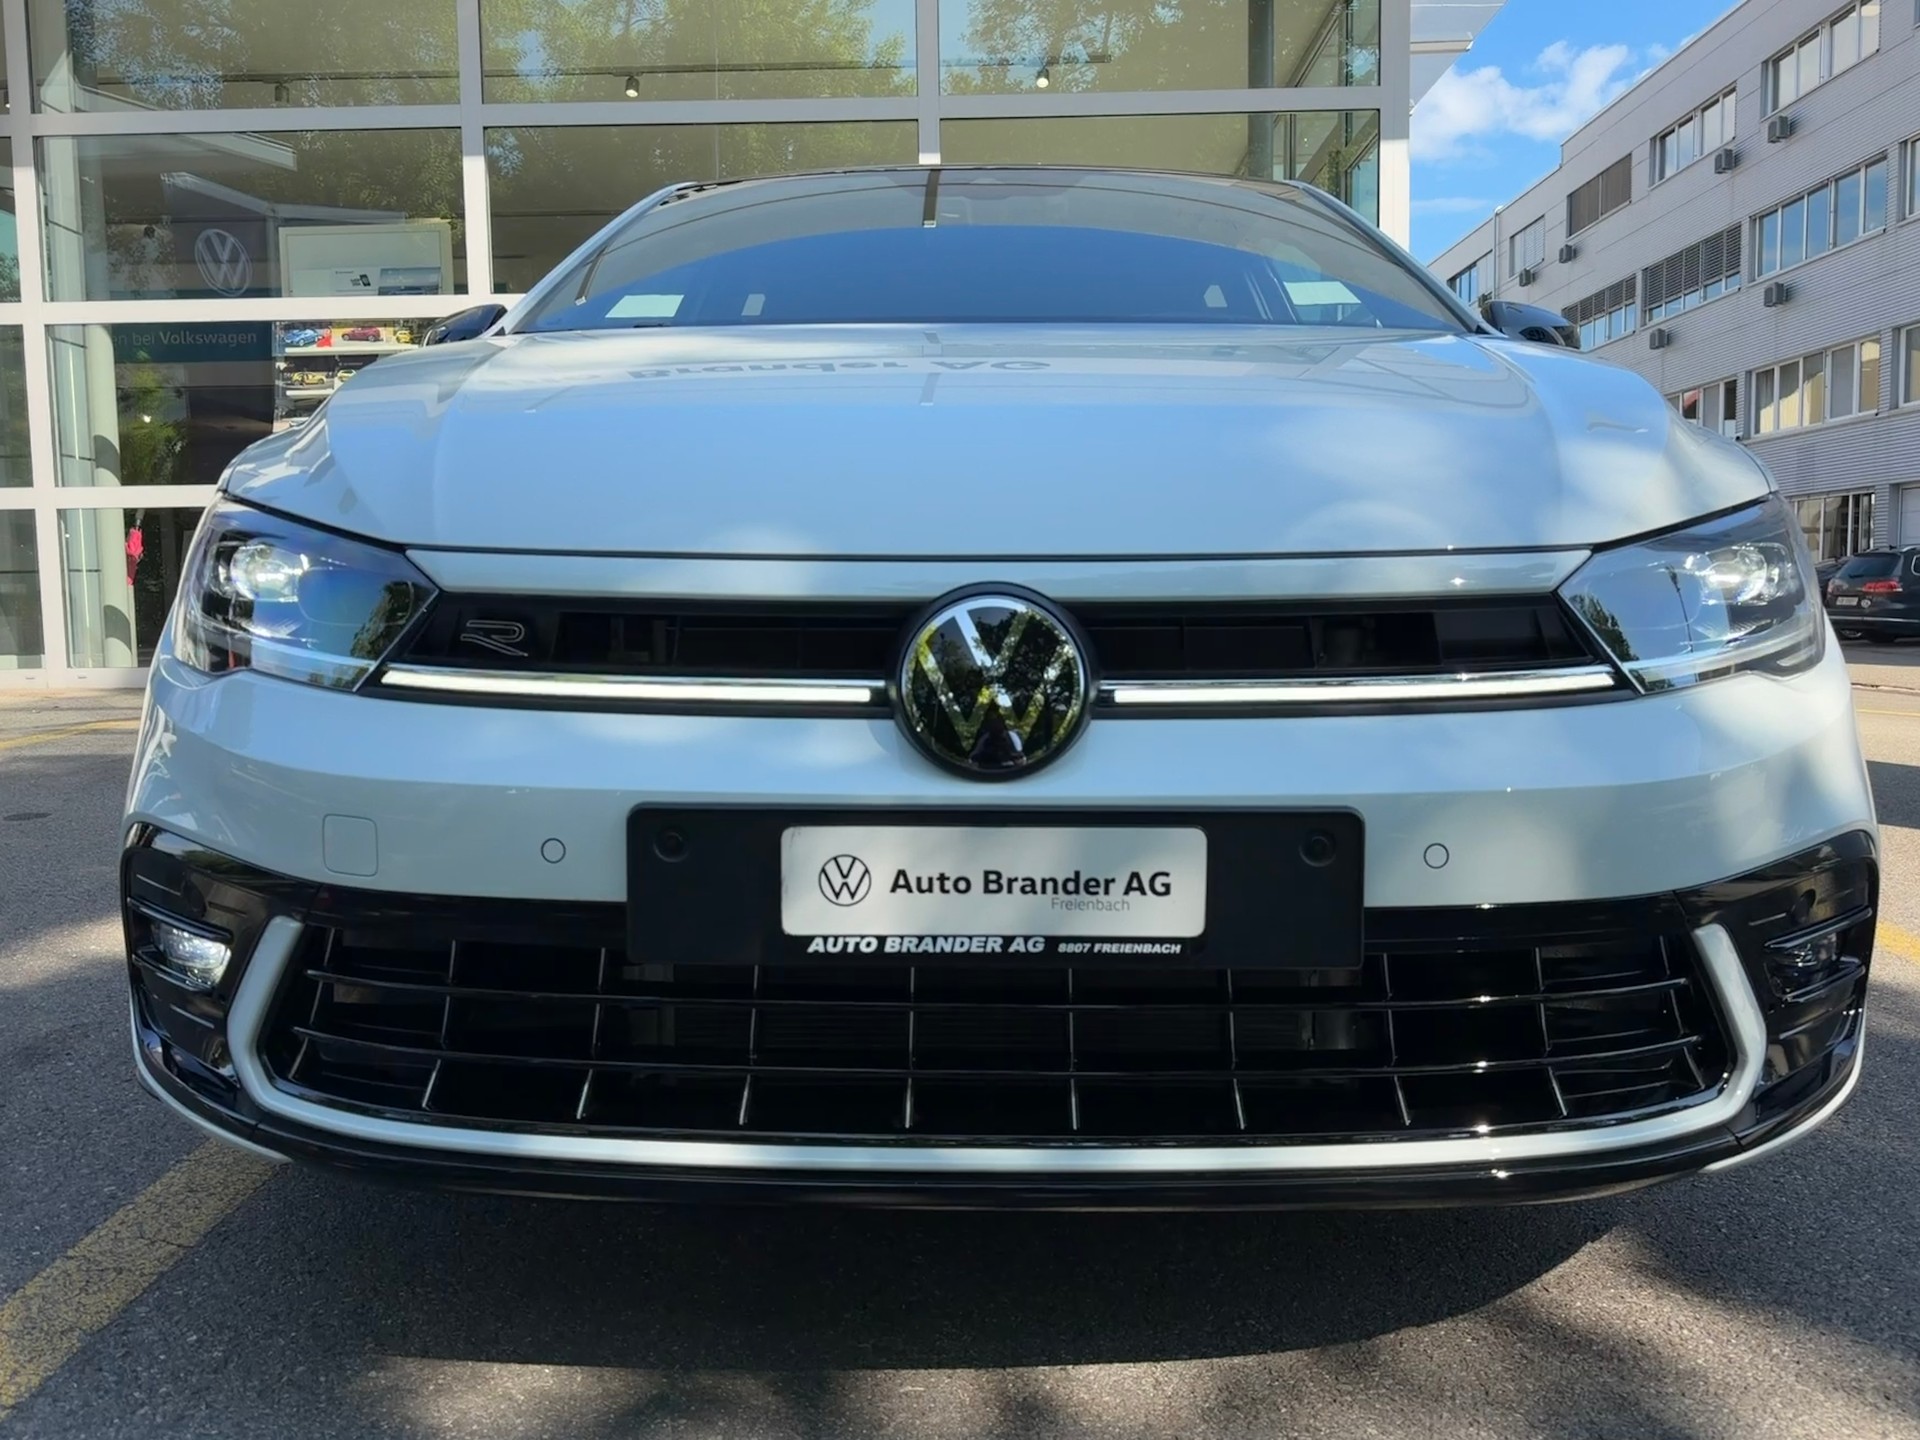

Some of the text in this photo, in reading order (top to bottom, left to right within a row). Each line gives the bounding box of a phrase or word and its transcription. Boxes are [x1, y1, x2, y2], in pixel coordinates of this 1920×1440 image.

[132, 331, 155, 346] bei
[160, 330, 257, 347] Volkswagen
[889, 868, 1172, 897] Auto Brander AG
[1051, 897, 1130, 912] Freienbach
[807, 936, 1182, 954] AUTO BRANDER AG 8807 FREIENBACH
